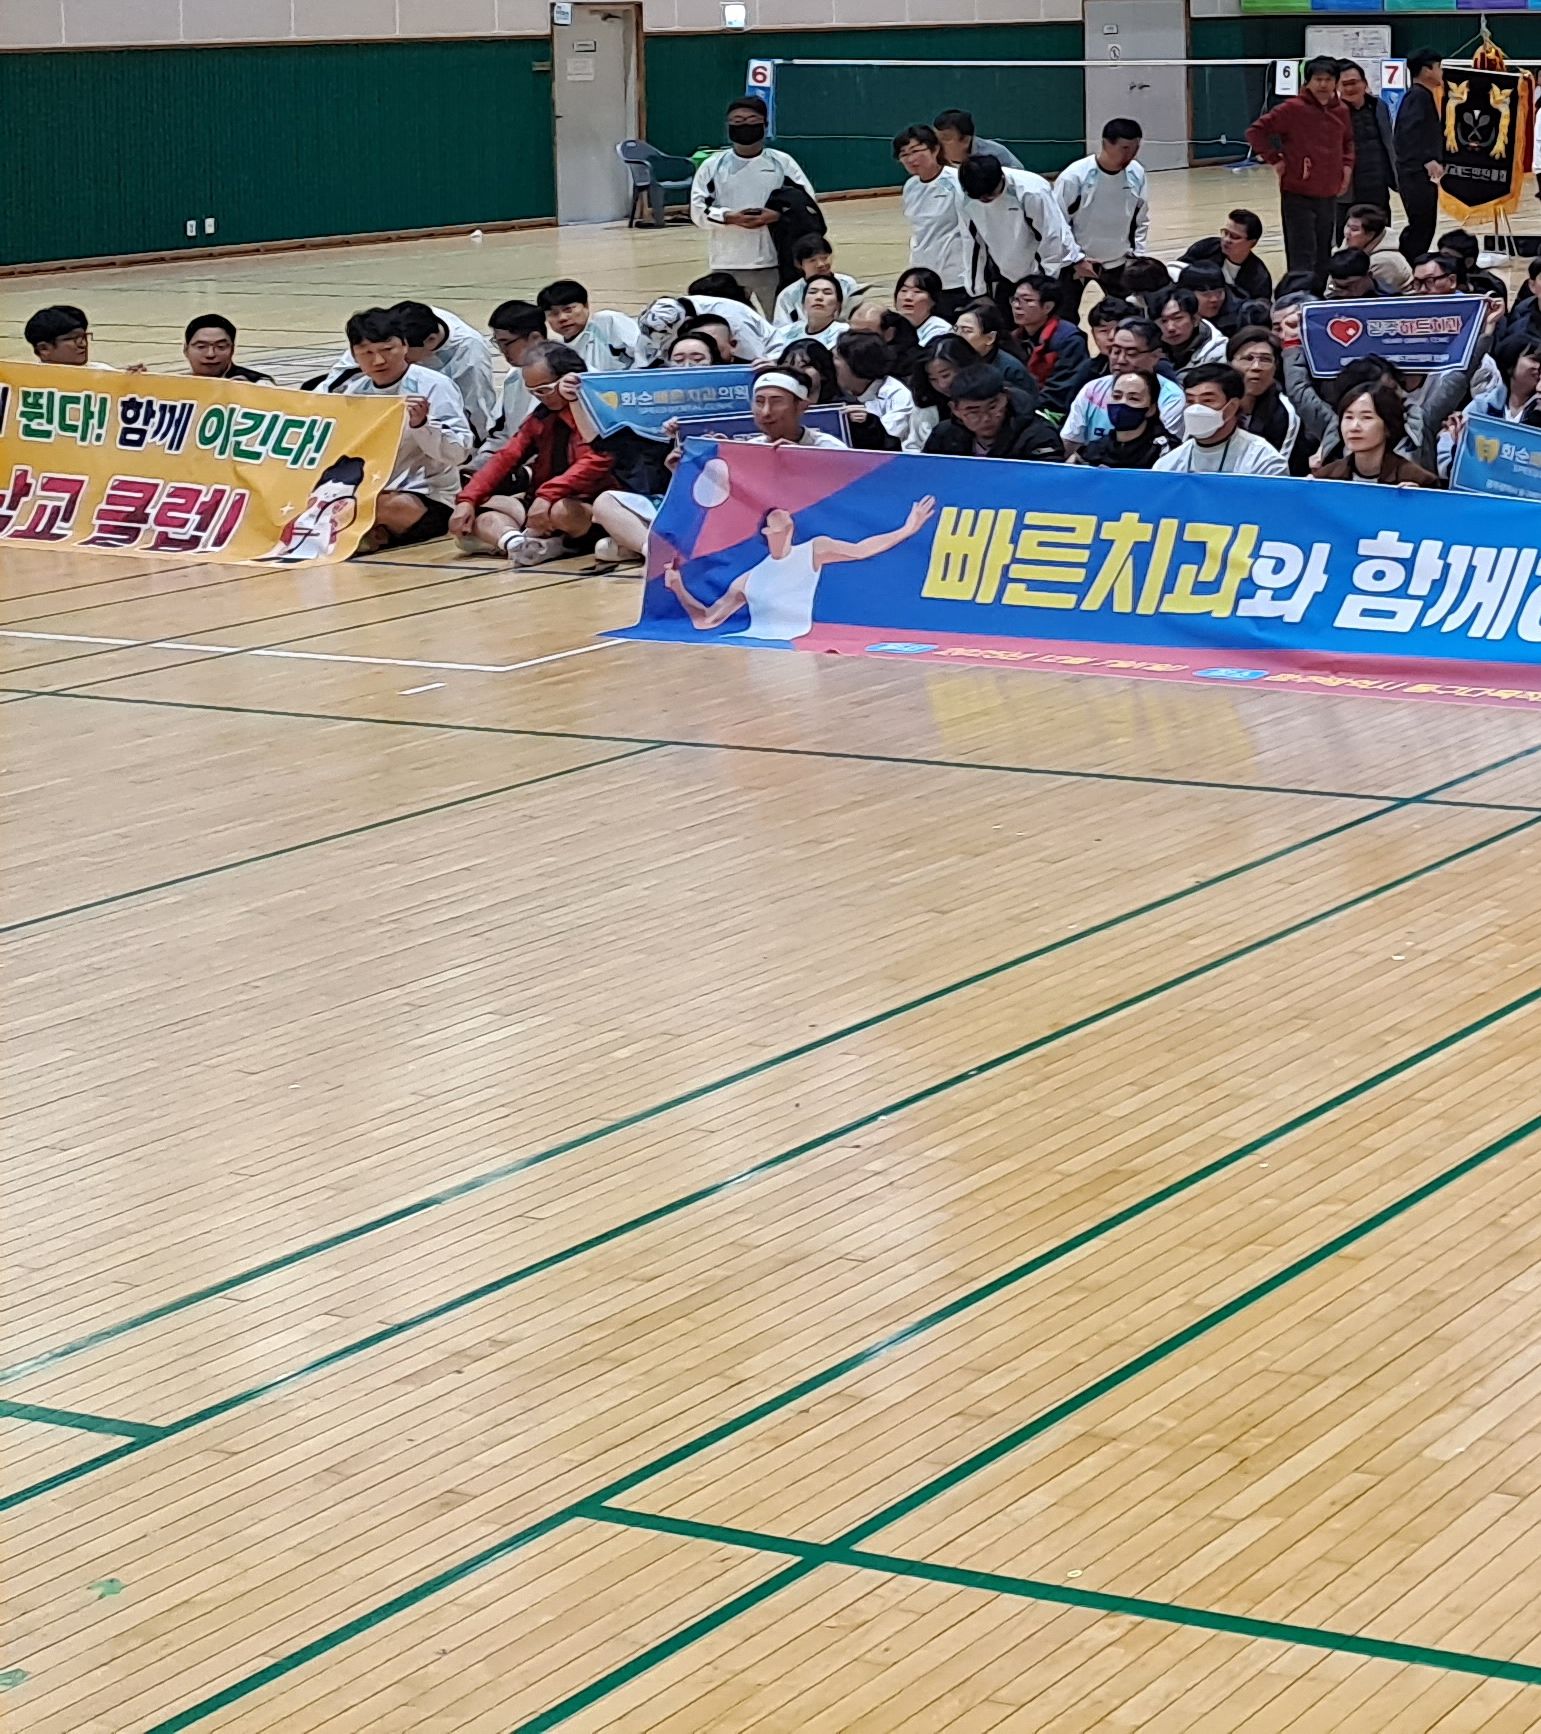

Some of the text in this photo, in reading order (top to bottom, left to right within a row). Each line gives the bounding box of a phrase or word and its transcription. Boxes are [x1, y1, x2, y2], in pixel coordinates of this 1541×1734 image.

[752, 65, 768, 83] 6
[1282, 65, 1291, 78] 6
[1384, 65, 1399, 85] 7
[18, 387, 107, 446] 뛴다!
[117, 395, 195, 453] 함께
[197, 403, 336, 469] 이긴다!
[74, 473, 249, 554] 클럽!
[920, 505, 1329, 620] 빠른치과와
